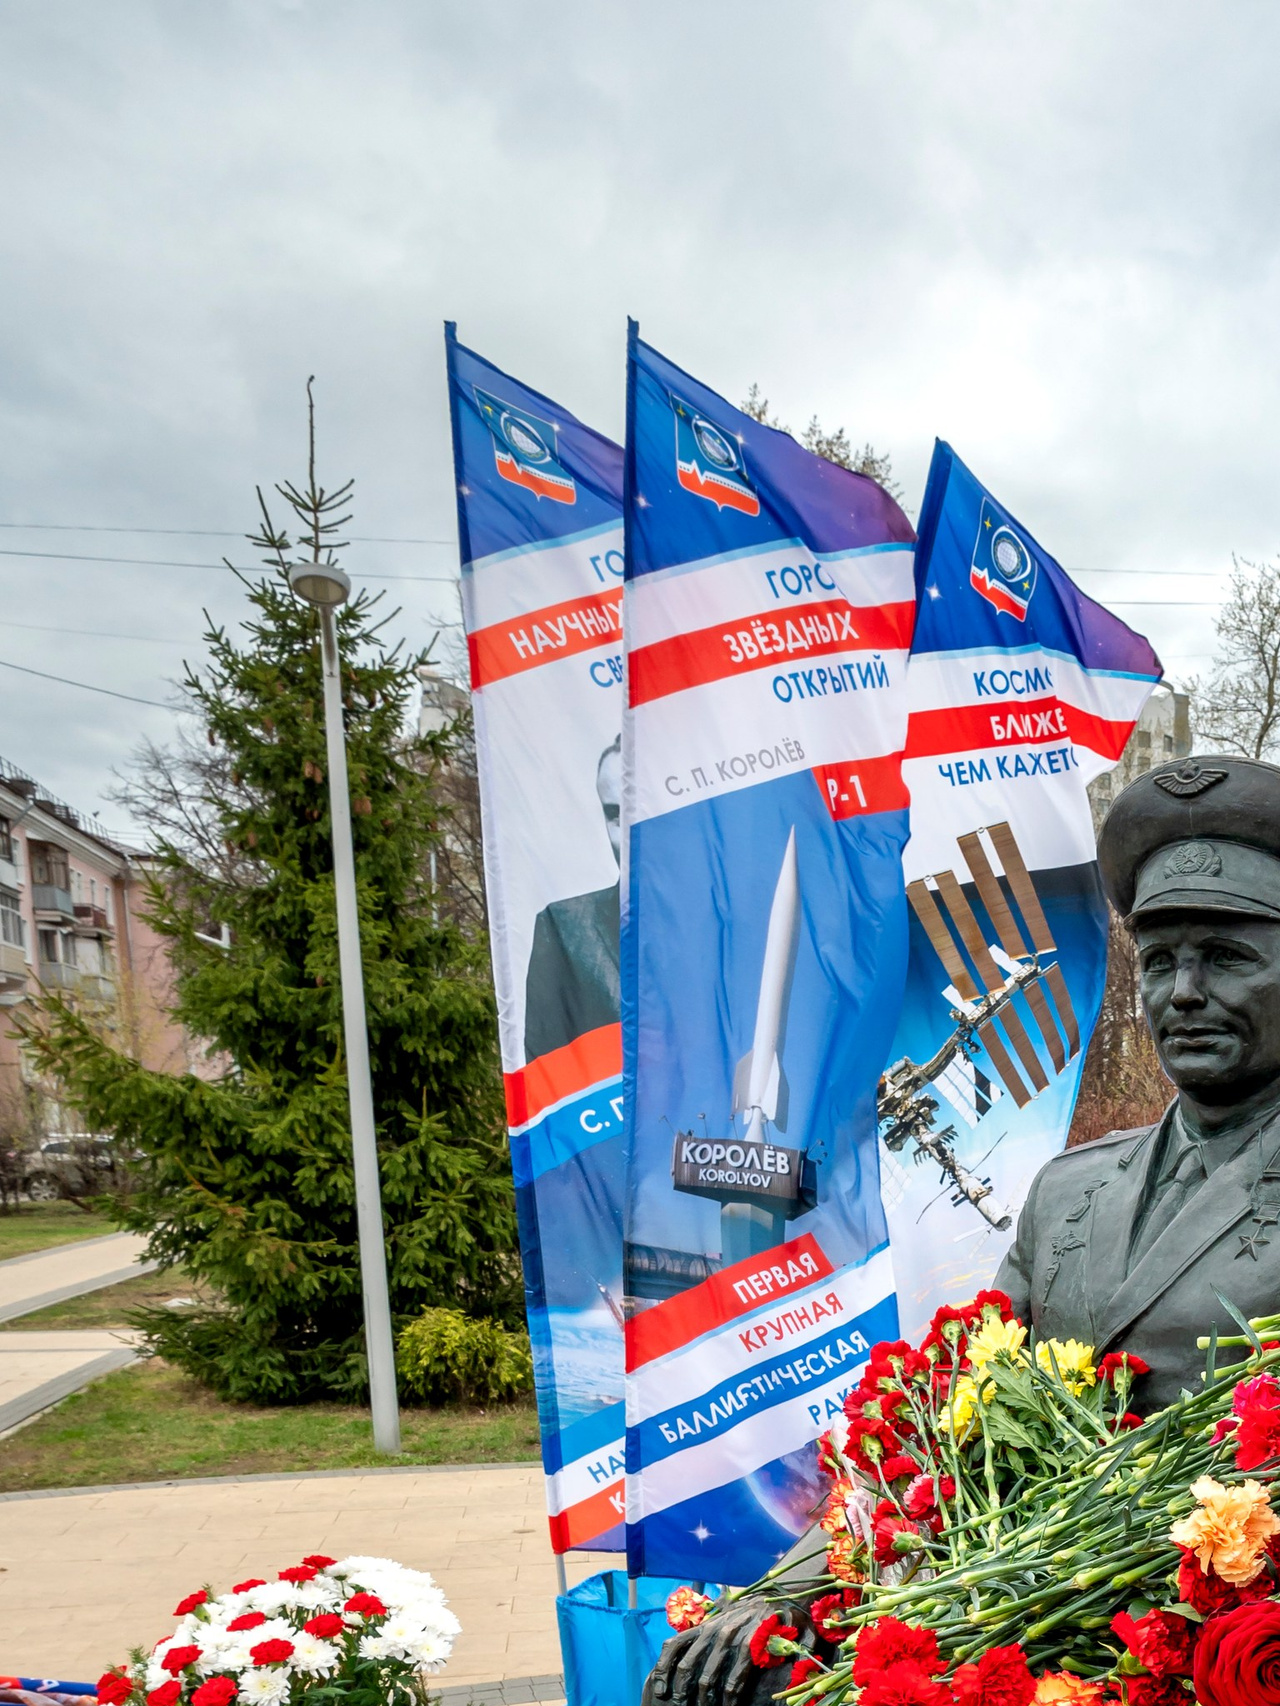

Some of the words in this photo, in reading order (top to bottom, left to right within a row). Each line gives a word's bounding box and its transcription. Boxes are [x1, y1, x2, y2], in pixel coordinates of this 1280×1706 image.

[722, 610, 860, 663] ЗВЁЗДНЫХ
[772, 654, 890, 703] ОТКРЫТИЙ
[989, 707, 1068, 740] БЛИЖЕ
[664, 775, 690, 797] С.
[691, 767, 714, 789] П.
[715, 737, 806, 782] КОРОЛЁВ
[938, 758, 992, 786] ЧЕМ
[826, 775, 868, 812] Р-1
[681, 1141, 790, 1174] КОРОЛЁВ
[698, 1168, 772, 1188] KOROLYOV
[732, 1252, 820, 1304] ПЕРВАЯ
[738, 1292, 843, 1353] КРУПНАЯ
